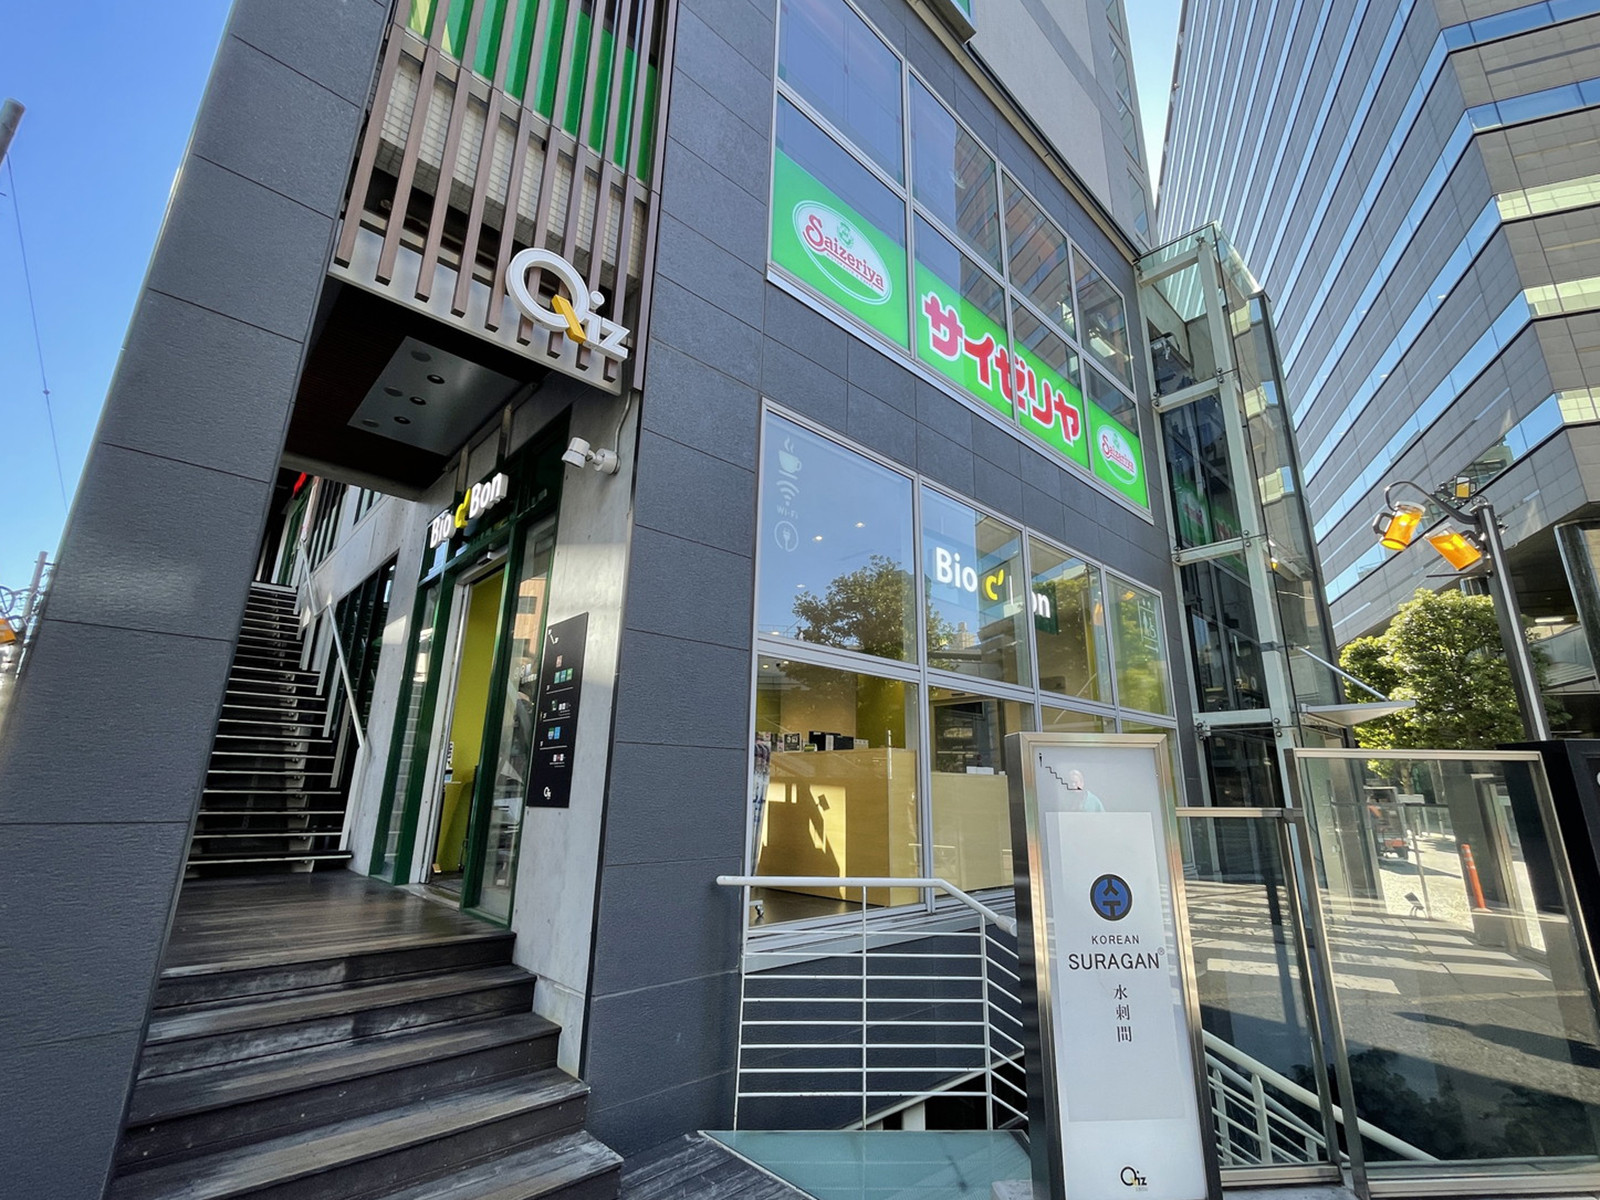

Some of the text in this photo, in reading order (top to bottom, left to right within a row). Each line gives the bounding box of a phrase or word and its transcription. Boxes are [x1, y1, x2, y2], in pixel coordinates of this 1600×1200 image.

[803, 214, 884, 291] Saizeriya
[922, 292, 1080, 447] サイゼリヤ
[430, 514, 455, 548] Bio
[469, 473, 508, 518] Bon
[936, 547, 978, 593] Bio
[1091, 935, 1140, 945] KOREAN
